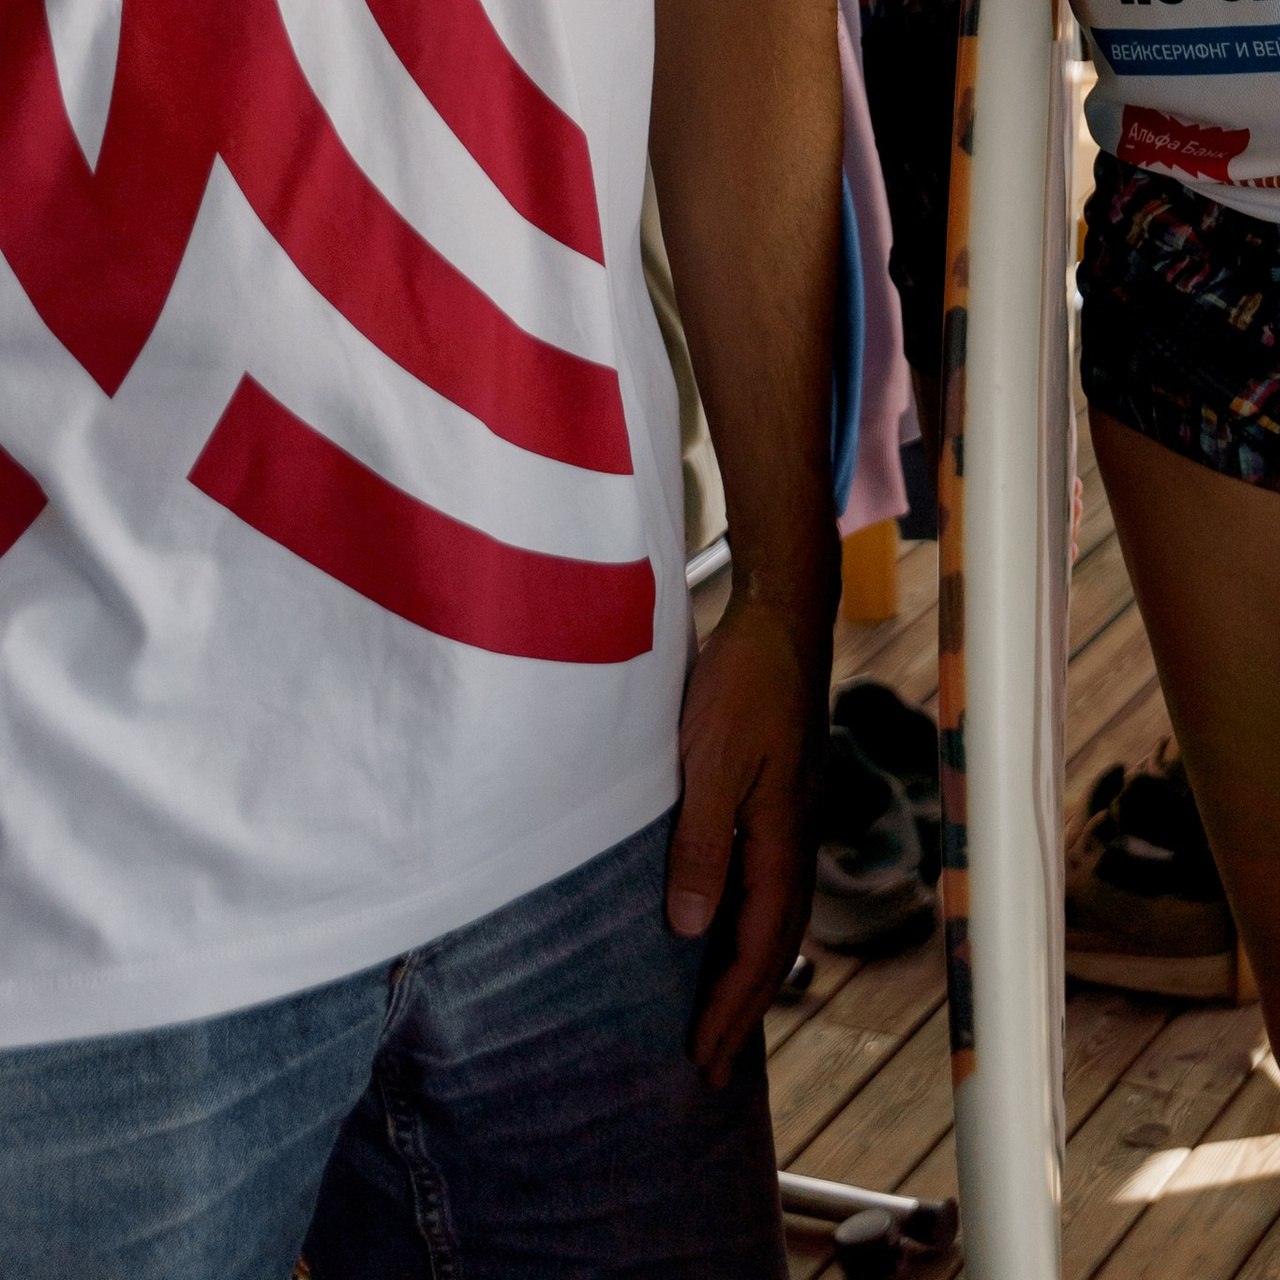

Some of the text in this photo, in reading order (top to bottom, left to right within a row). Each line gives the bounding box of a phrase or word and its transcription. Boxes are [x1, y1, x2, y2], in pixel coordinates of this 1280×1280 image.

[1111, 41, 1230, 61] ВЕЙКСЕРИФНГ
[1235, 42, 1250, 58] И
[1128, 122, 1230, 159] Альфа Банк
